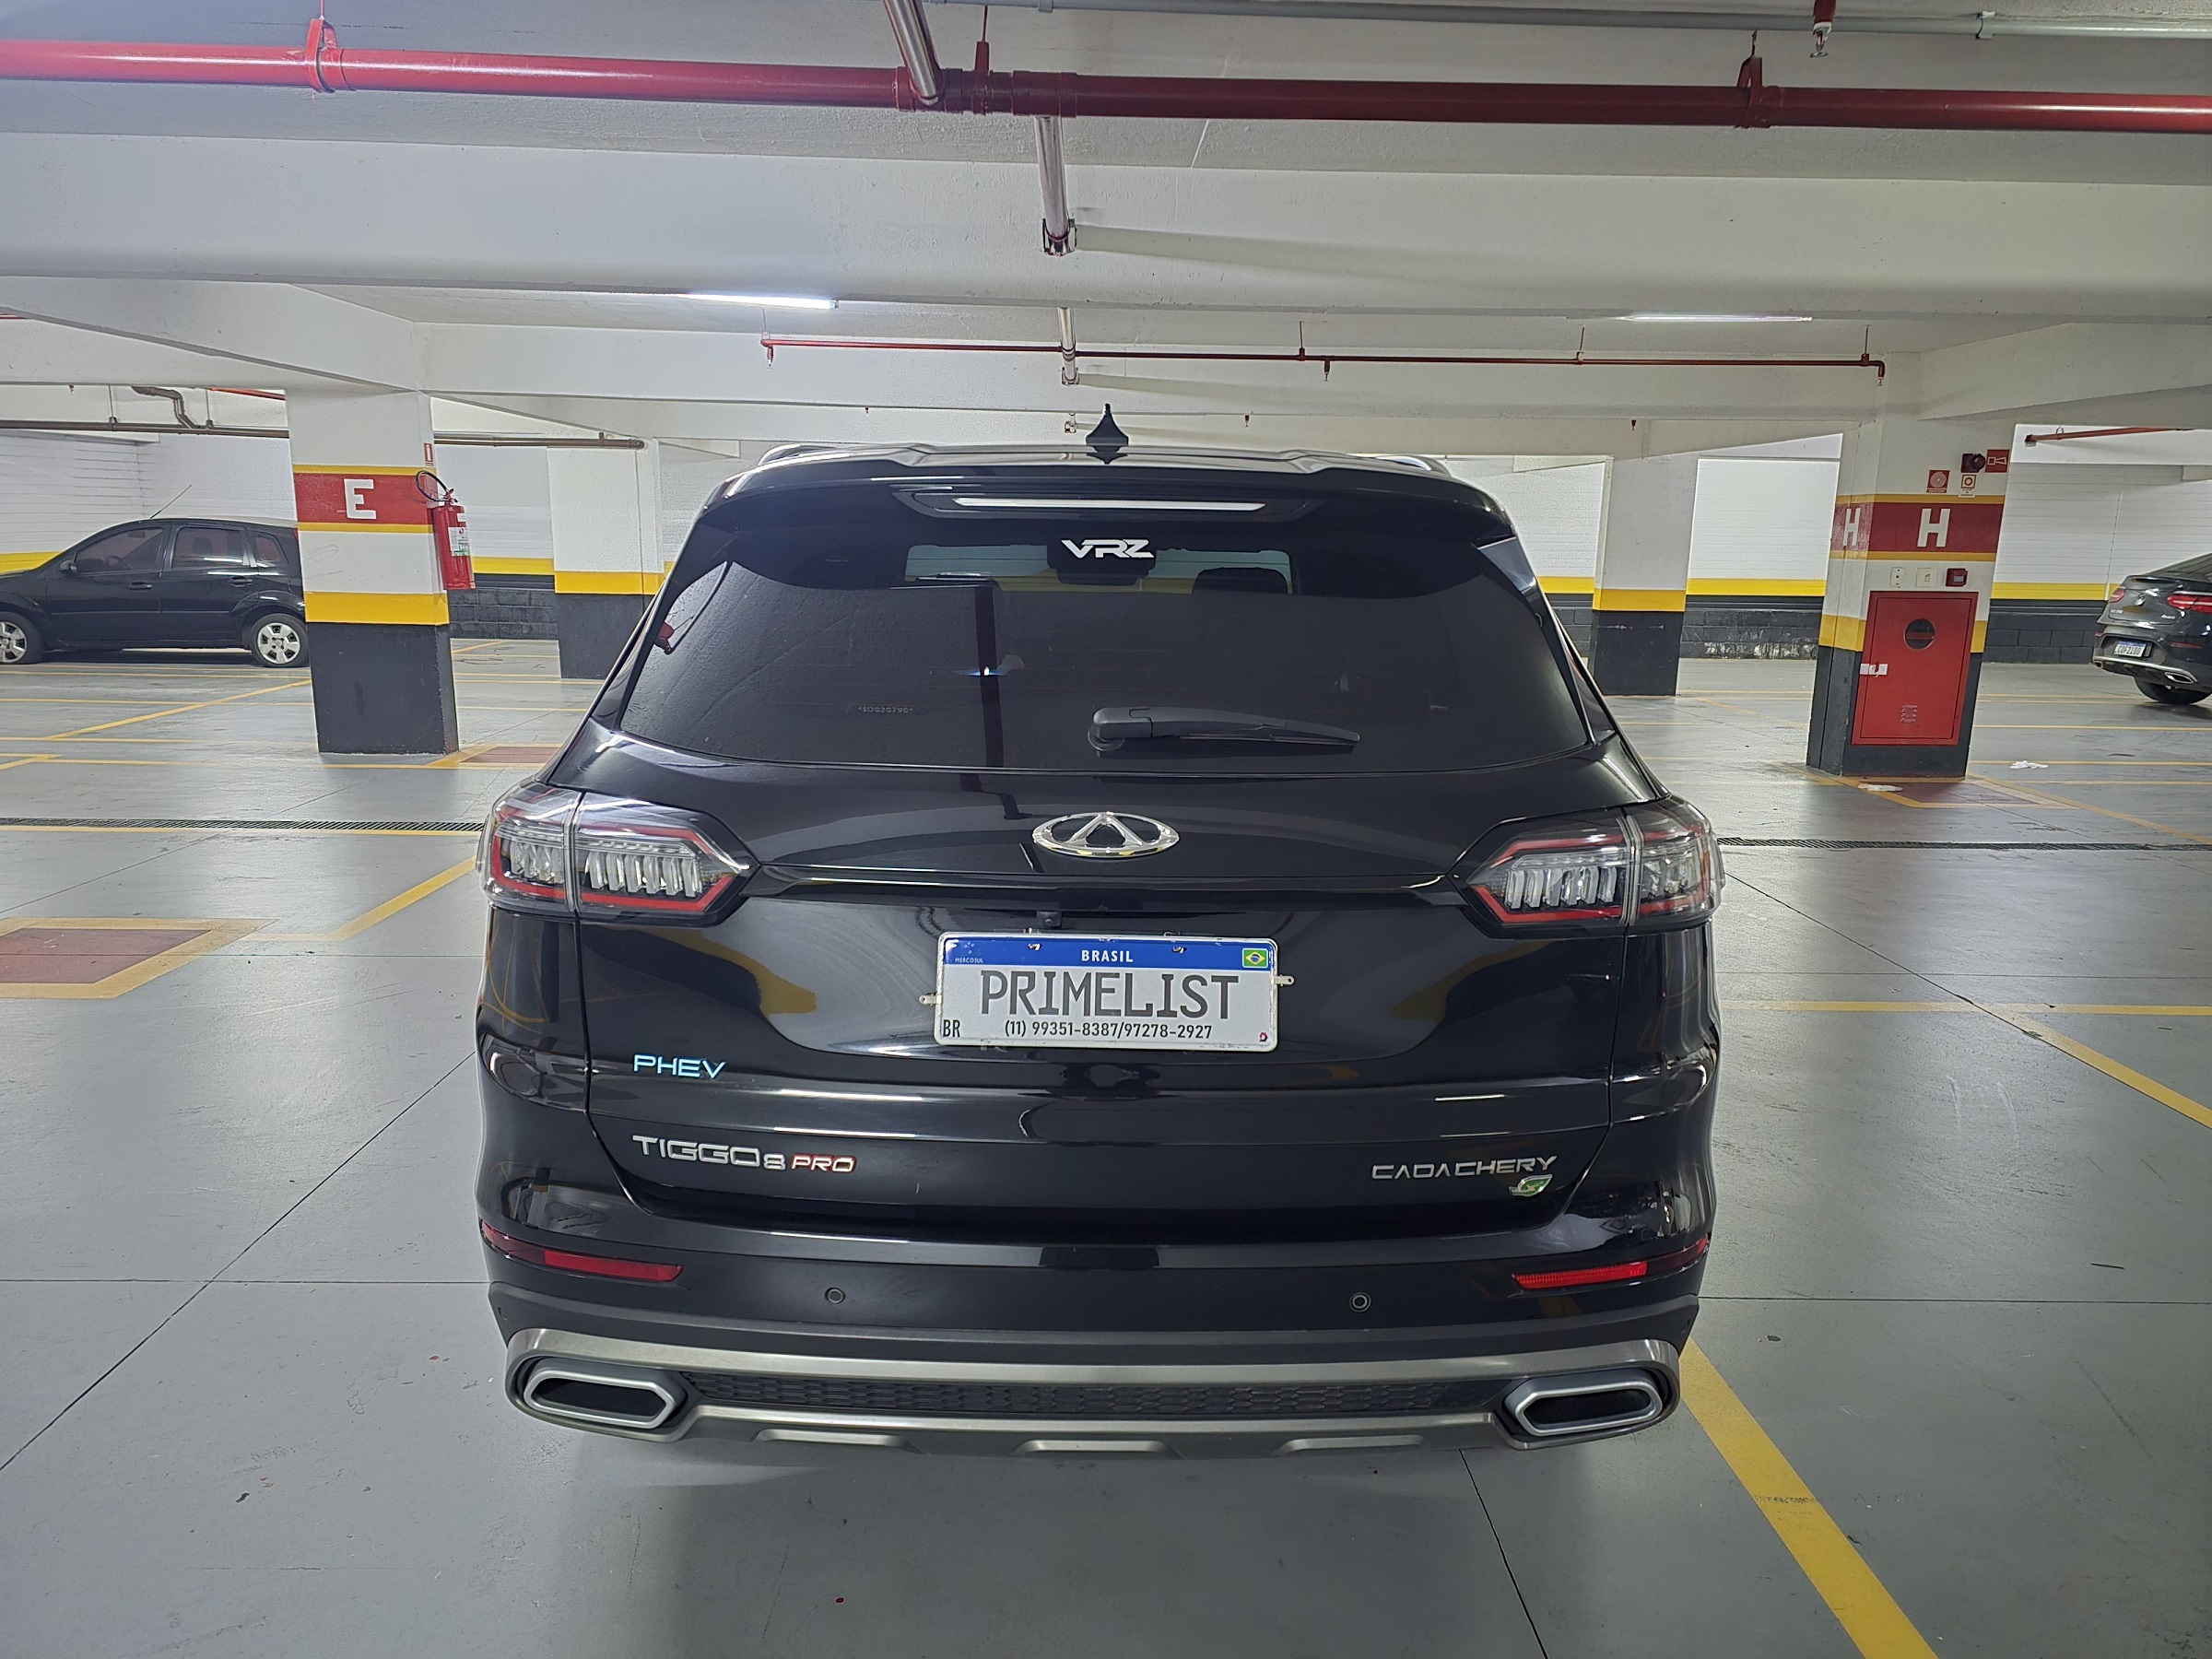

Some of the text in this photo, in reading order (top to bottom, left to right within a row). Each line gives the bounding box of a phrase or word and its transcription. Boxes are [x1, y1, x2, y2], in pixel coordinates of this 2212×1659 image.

[344, 478, 376, 519] E
[1843, 508, 1862, 547] H
[1917, 508, 1950, 547] H
[1061, 538, 1154, 559] VRZ
[1081, 948, 1134, 964] BRASIL
[981, 970, 1239, 1019] PRIMELIST
[942, 1019, 960, 1038] BR
[1005, 1020, 1213, 1040] (11) 99351-8387/97278-2927
[634, 1053, 726, 1079] PHEV
[791, 1154, 857, 1173] PRO
